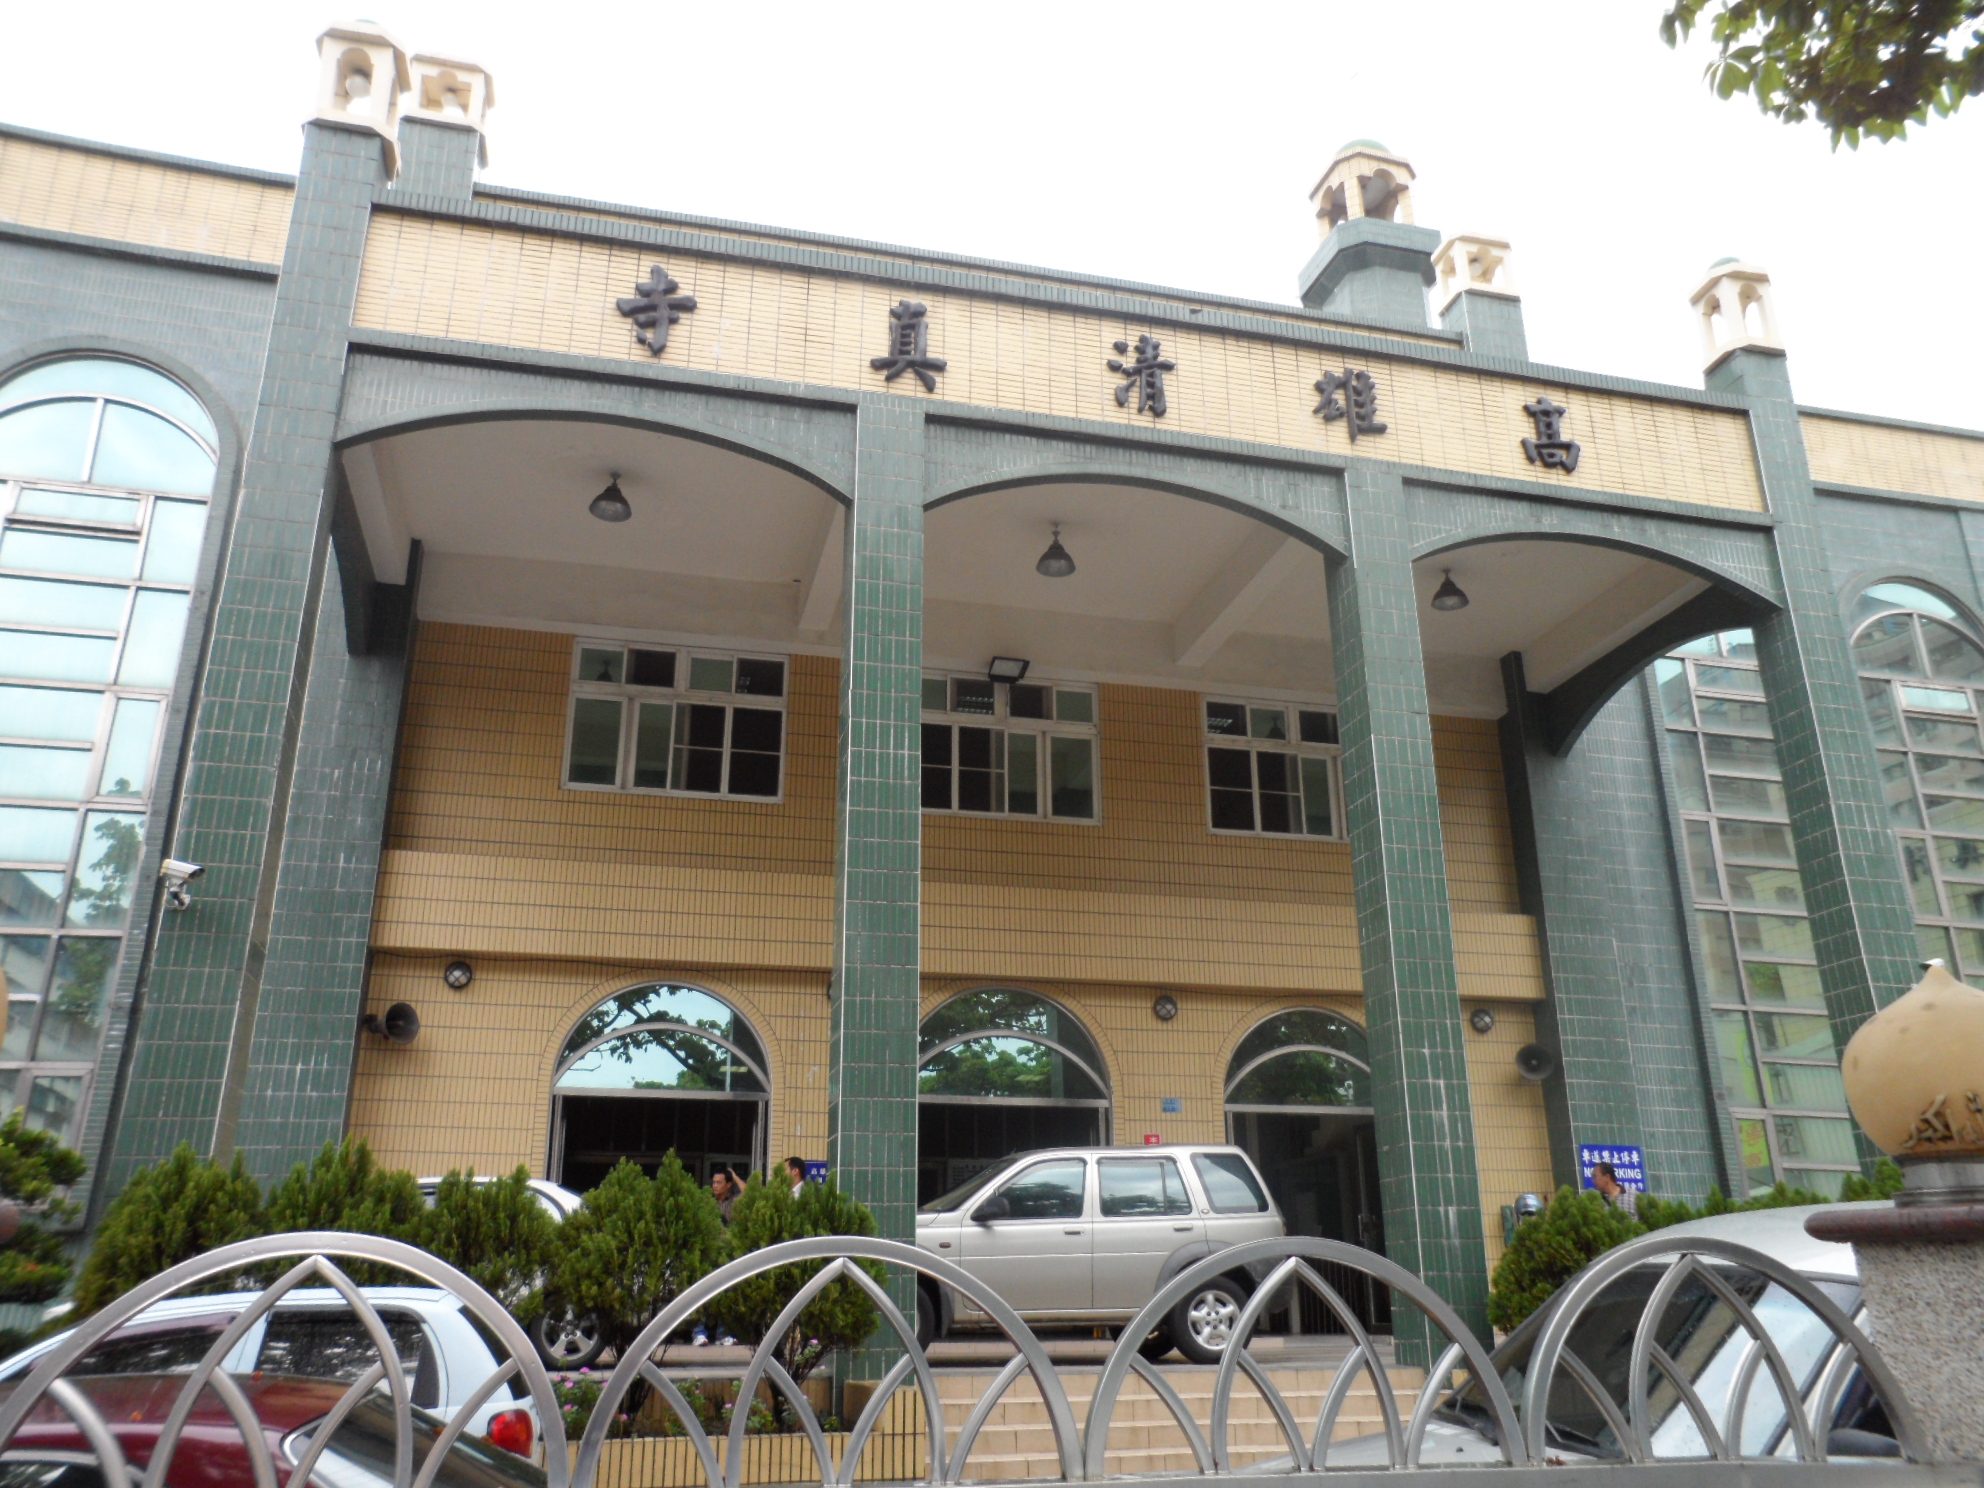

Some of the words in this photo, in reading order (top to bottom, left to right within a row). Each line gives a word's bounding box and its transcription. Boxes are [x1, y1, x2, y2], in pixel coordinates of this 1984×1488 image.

[1581, 1148, 1640, 1166] 車道禁止停車
